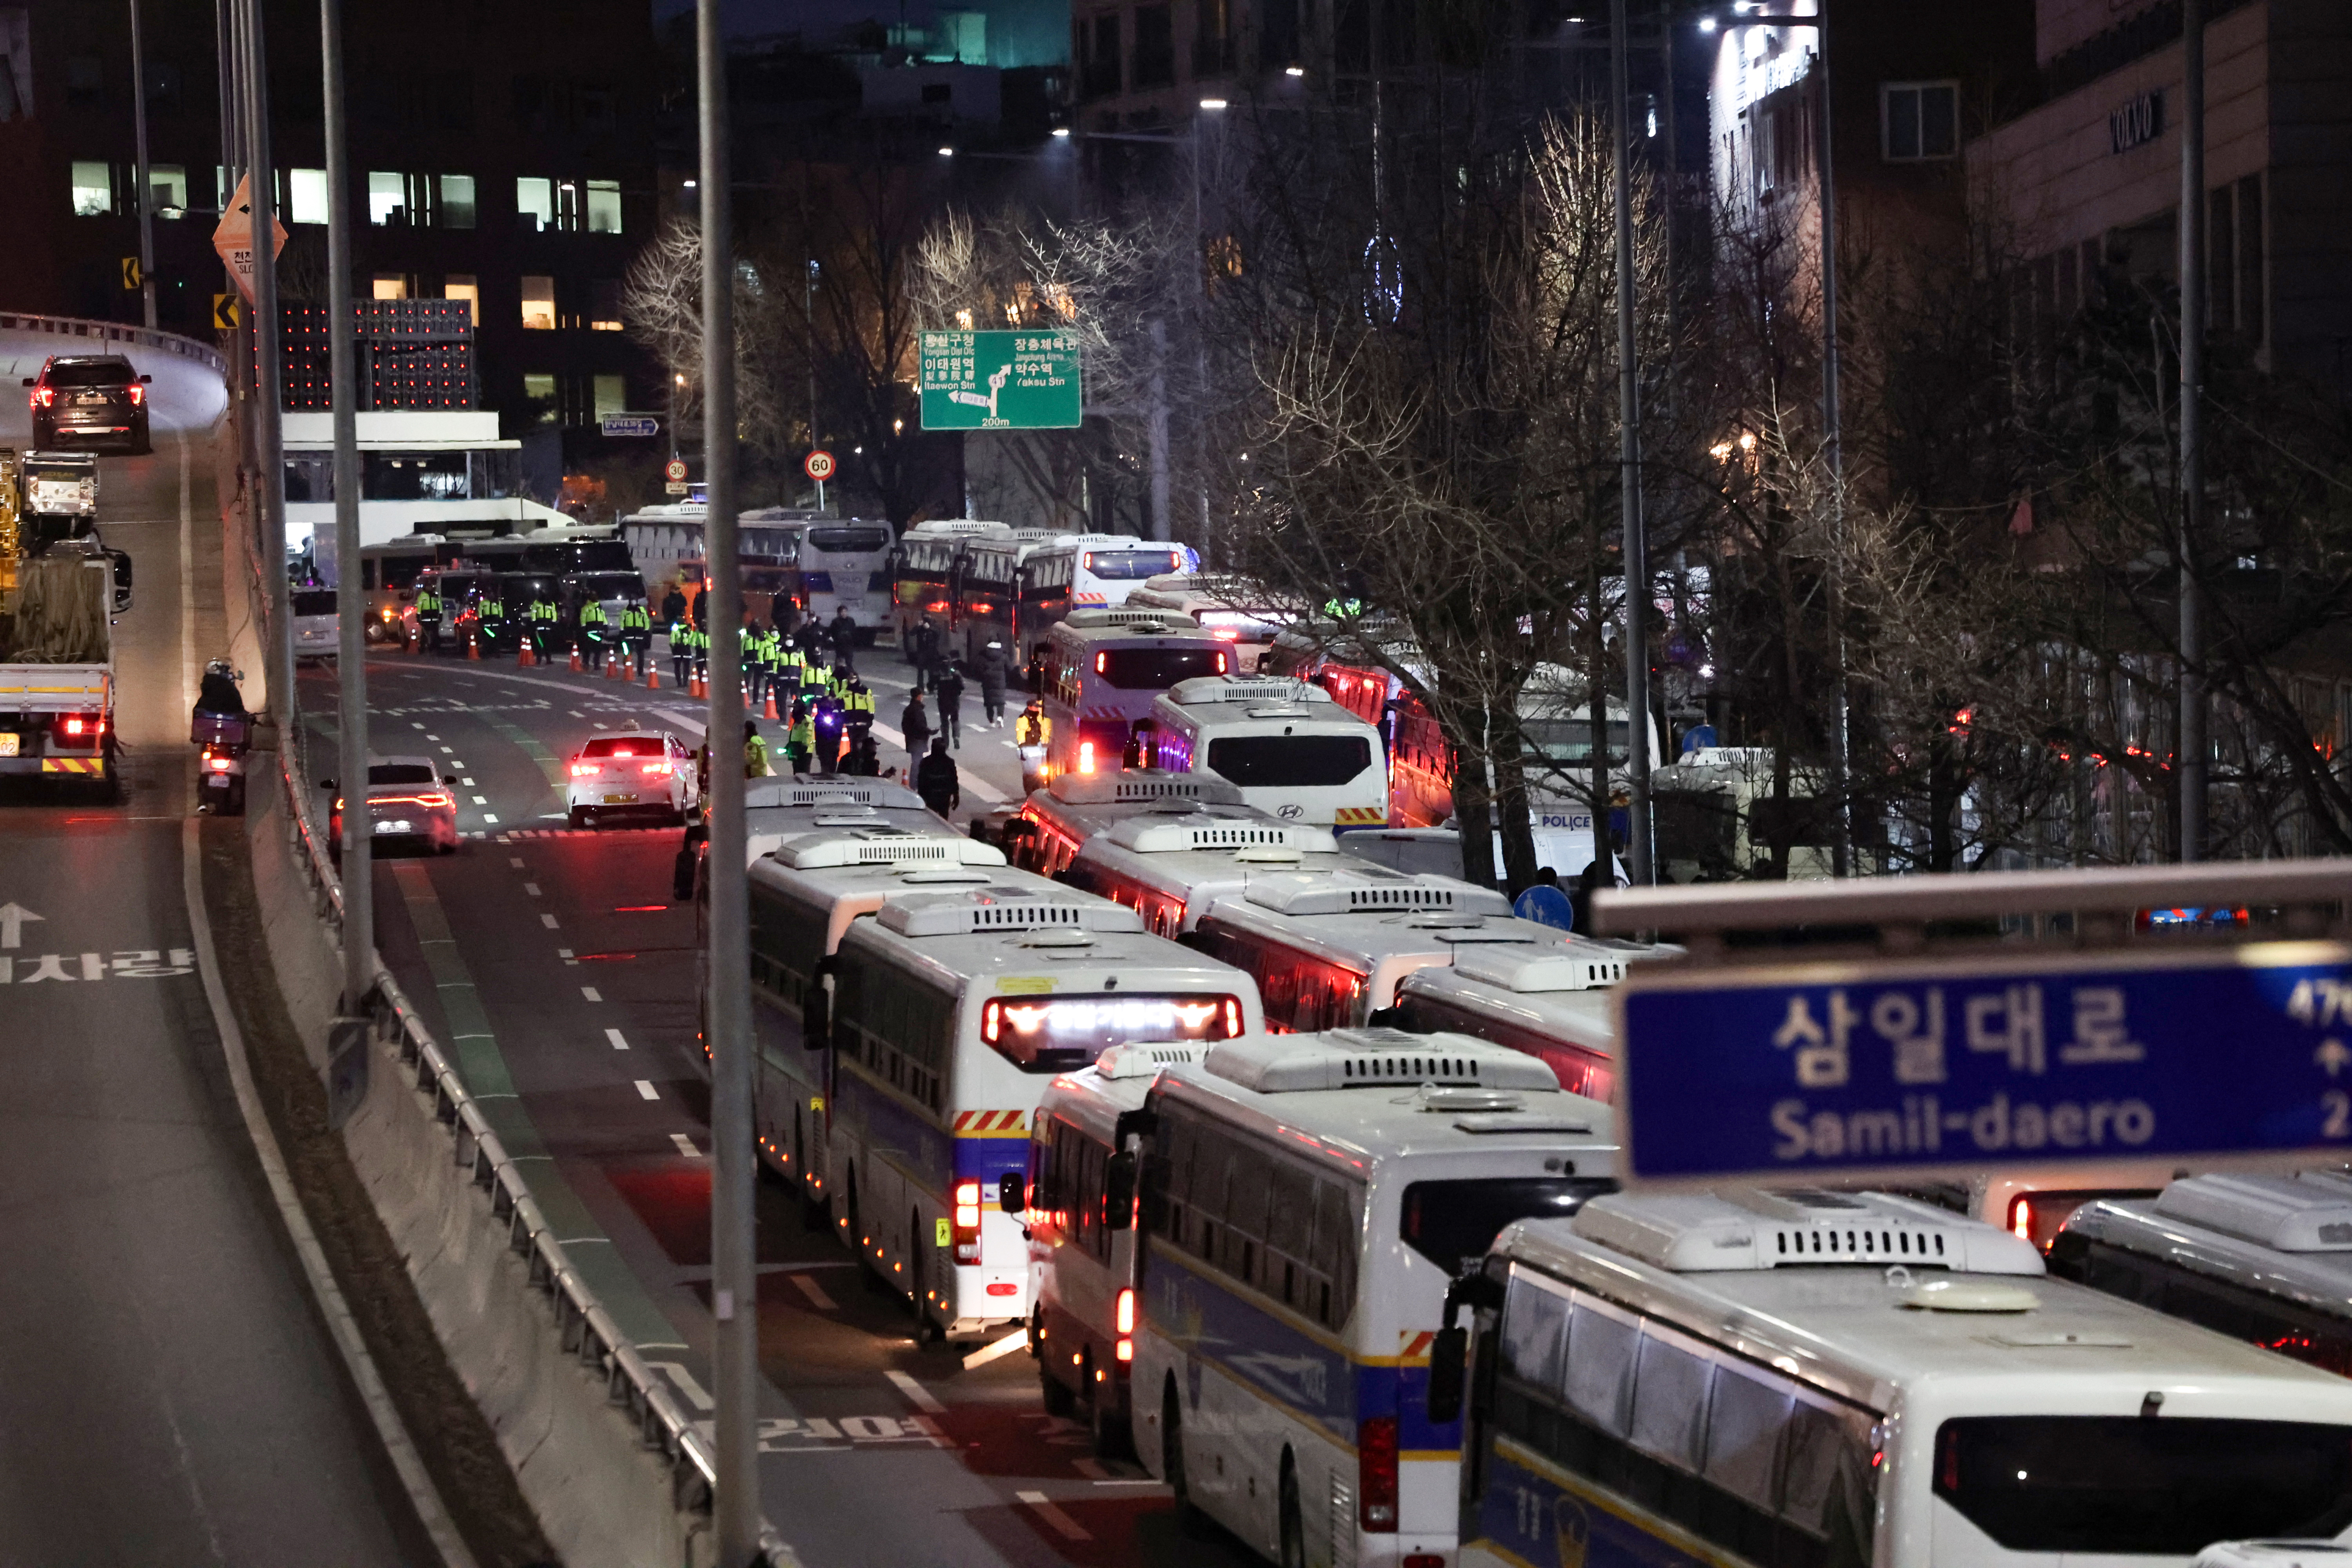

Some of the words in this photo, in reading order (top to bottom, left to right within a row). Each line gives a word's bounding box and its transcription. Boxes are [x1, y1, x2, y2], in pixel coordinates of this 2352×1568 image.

[234, 251, 253, 264] 천천
[239, 265, 253, 274] SLO
[924, 333, 974, 347] 용산구청
[1014, 337, 1078, 352] 장충체육관
[924, 347, 950, 357] Yongsan
[1014, 353, 1045, 363] Jangchung
[925, 357, 974, 370] 이태원역
[1015, 362, 1053, 376] 약수역
[924, 381, 959, 390] Itaewon
[960, 380, 975, 390] Stn
[991, 376, 1003, 386] 41
[1048, 377, 1065, 387] Stn
[982, 417, 1010, 427] 200m
[670, 465, 683, 475] 30
[812, 459, 828, 472] 60
[1542, 815, 1591, 827] POLICE
[0, 948, 196, 984] 차량
[1772, 984, 2147, 1088] 삼일대로
[1770, 1093, 2156, 1160] Samil-daero
